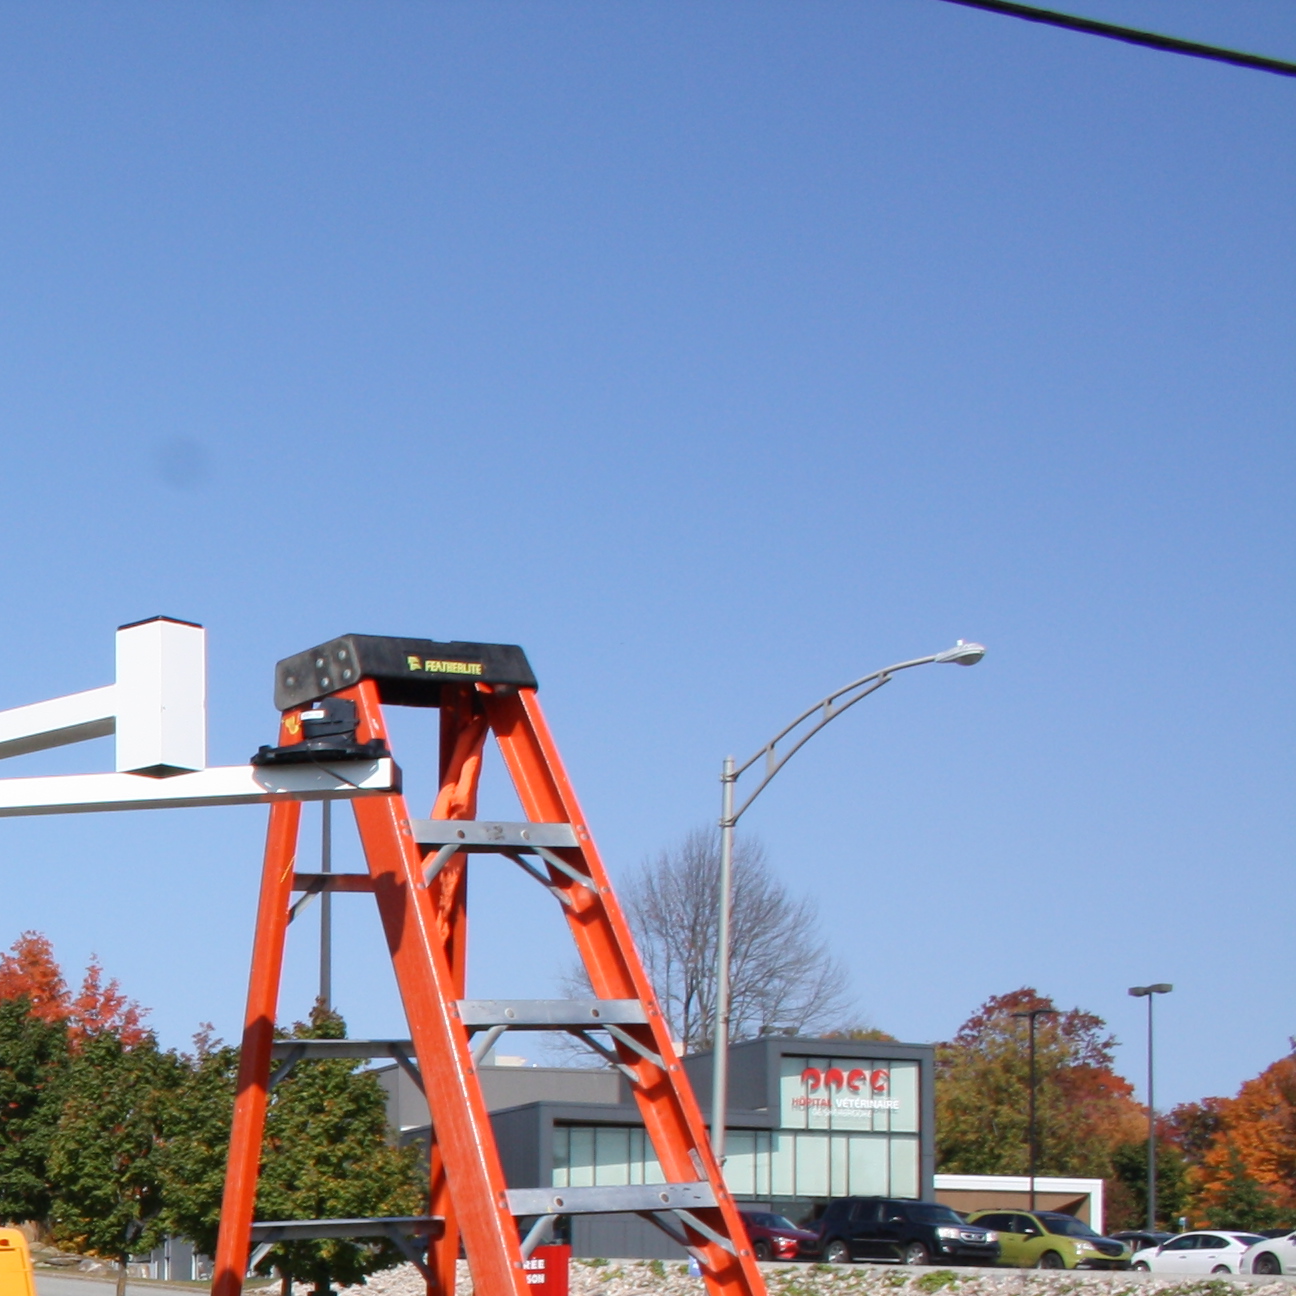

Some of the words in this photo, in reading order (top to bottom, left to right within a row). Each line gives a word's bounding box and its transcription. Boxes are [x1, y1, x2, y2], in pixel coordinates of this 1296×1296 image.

[424, 659, 482, 676] FEATHERLITE
[792, 1095, 832, 1108] HÔPITAL
[835, 1096, 900, 1110] VÉTÉRINAIRE
